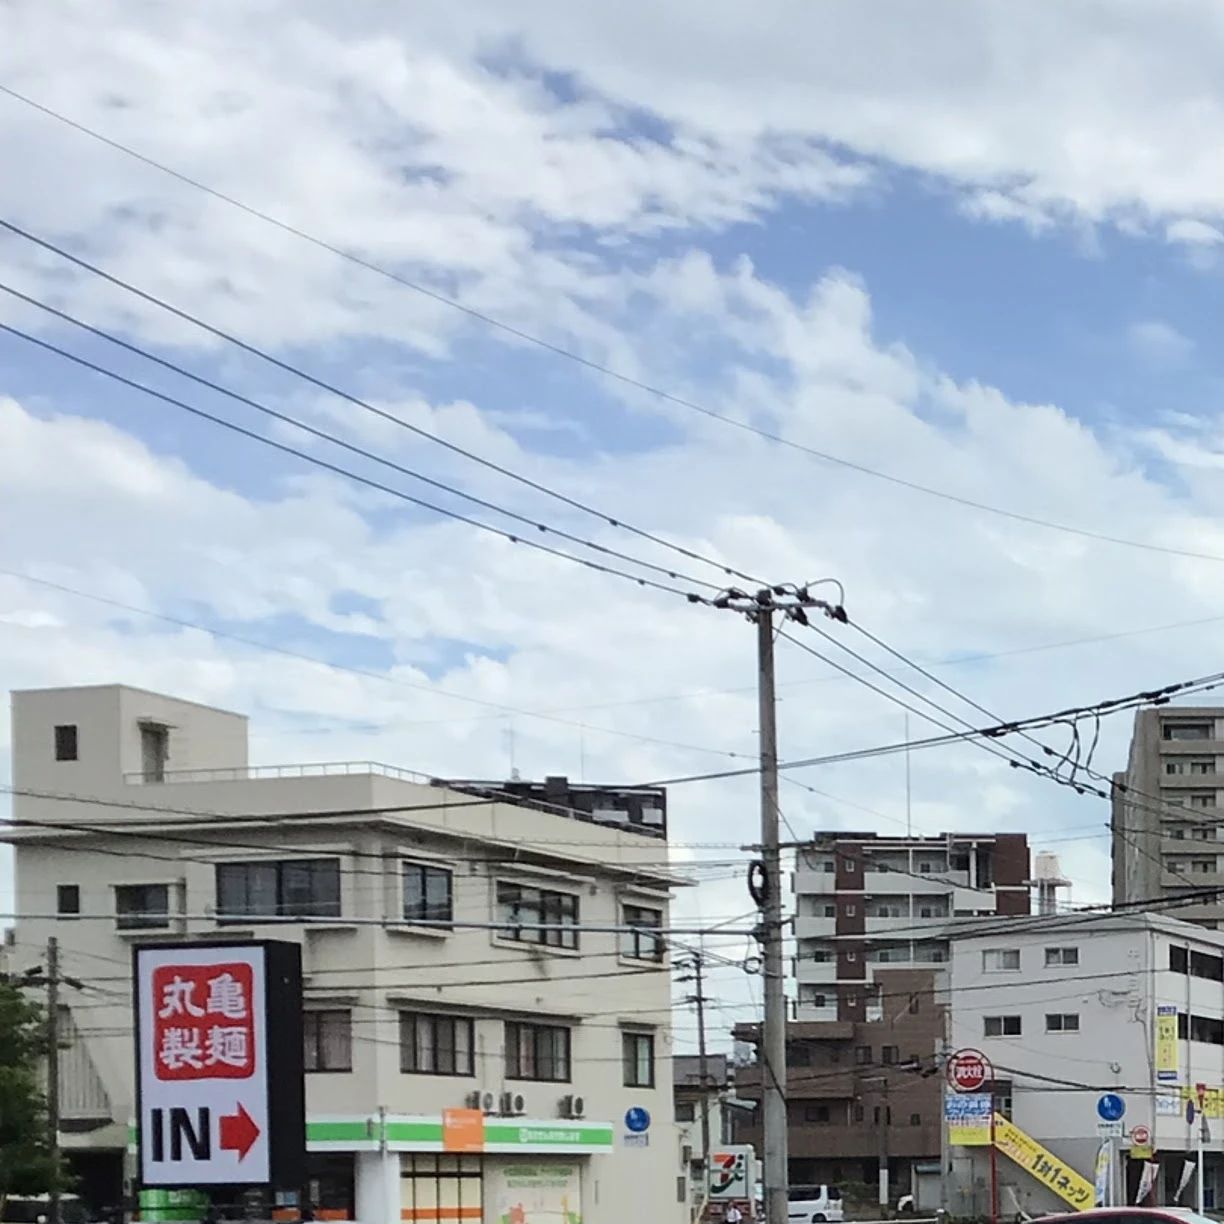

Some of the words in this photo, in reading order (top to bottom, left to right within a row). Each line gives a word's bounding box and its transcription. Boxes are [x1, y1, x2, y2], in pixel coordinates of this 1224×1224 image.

[158, 972, 247, 1019] 丸亀
[159, 1025, 248, 1071] 製麺
[151, 1106, 211, 1163] IN
